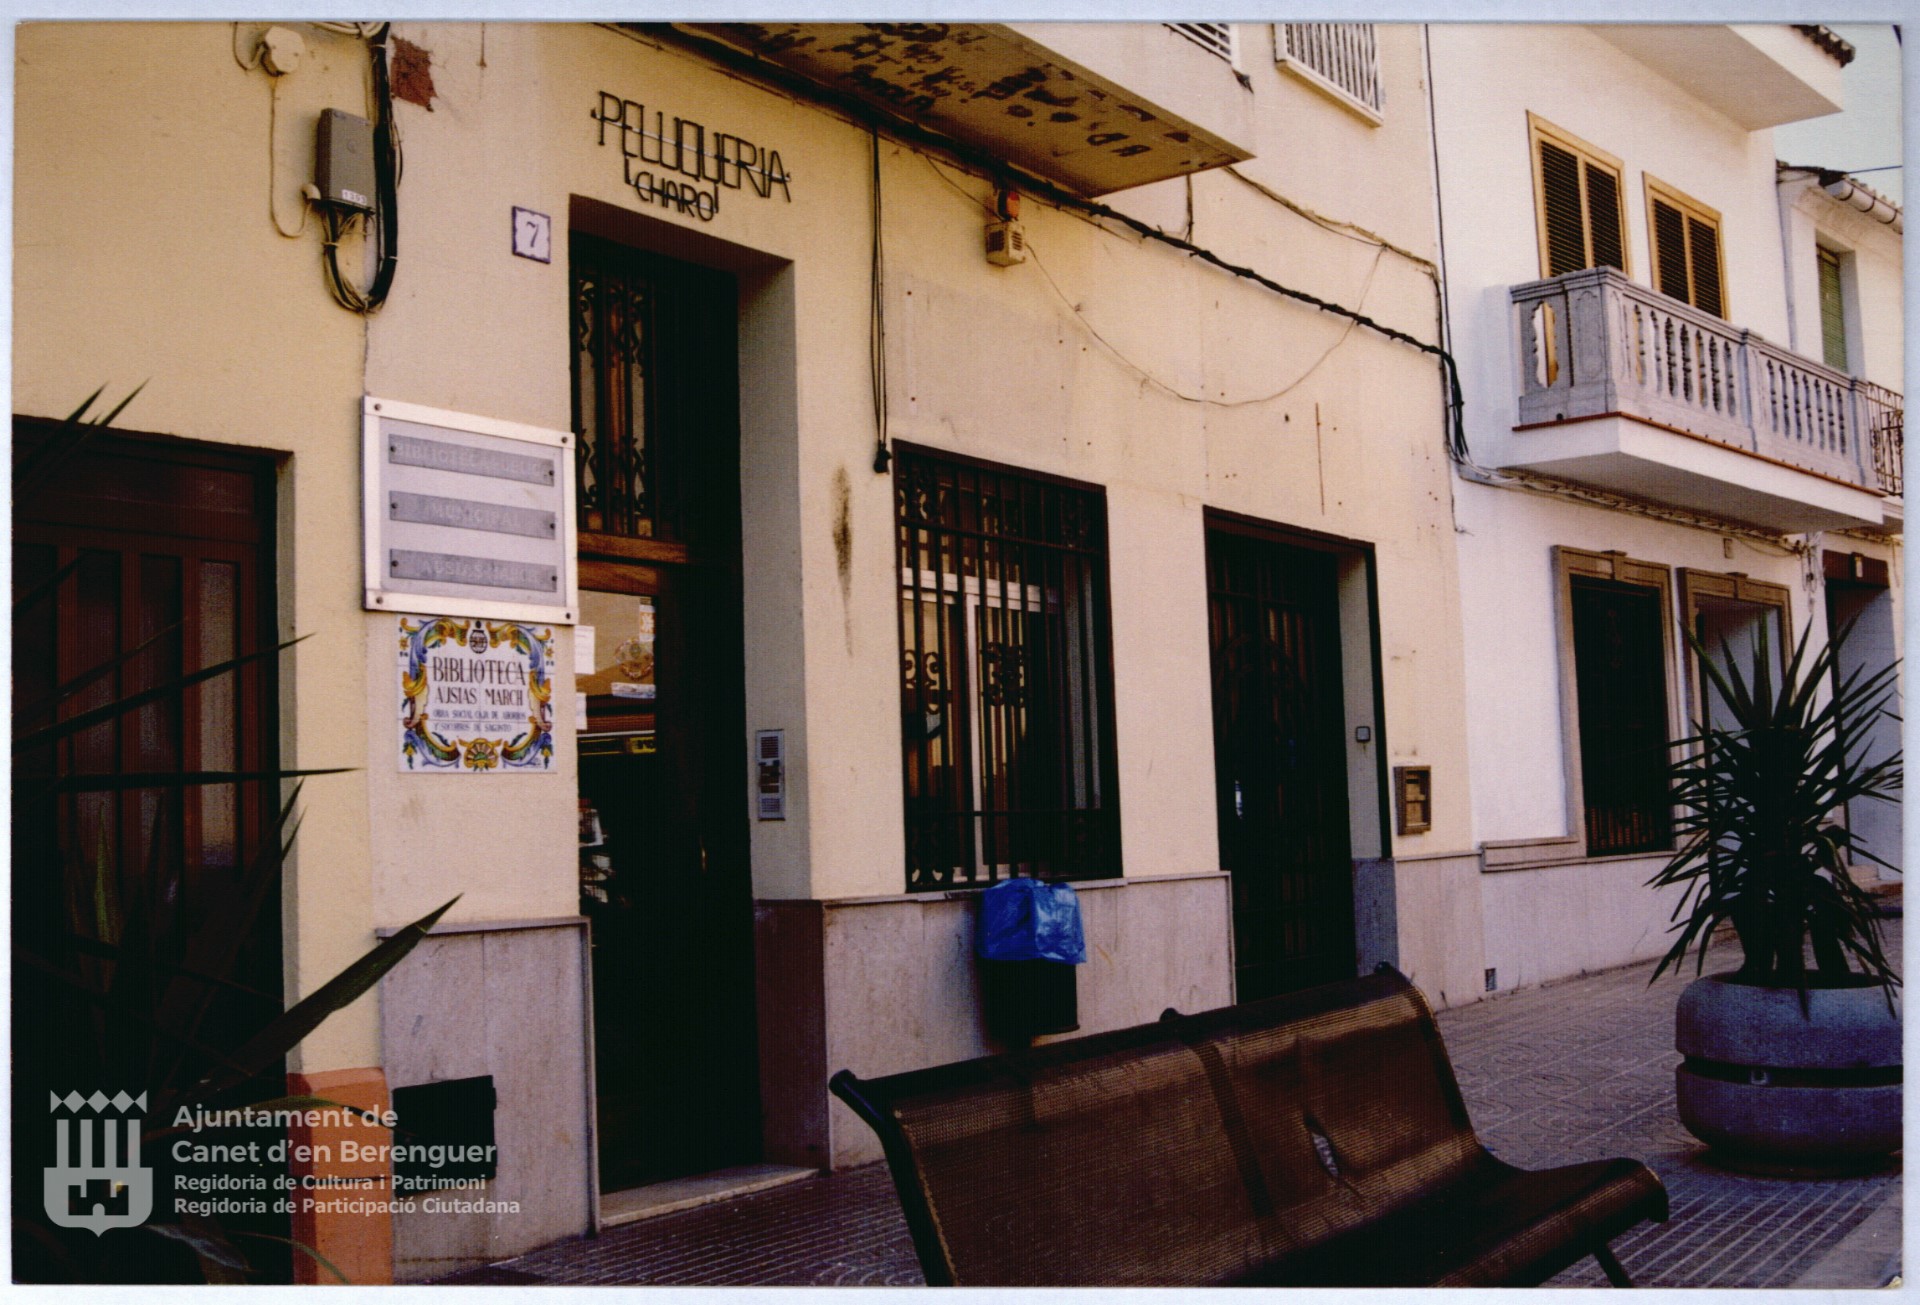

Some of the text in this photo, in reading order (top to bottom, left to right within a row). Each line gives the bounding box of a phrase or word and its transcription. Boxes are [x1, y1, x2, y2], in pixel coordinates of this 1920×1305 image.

[599, 90, 791, 203] PELUQUERIA
[634, 171, 714, 222] CHARO
[526, 220, 540, 248] 7
[433, 656, 526, 686] BIBLIOTECA
[485, 688, 523, 706] MARCH
